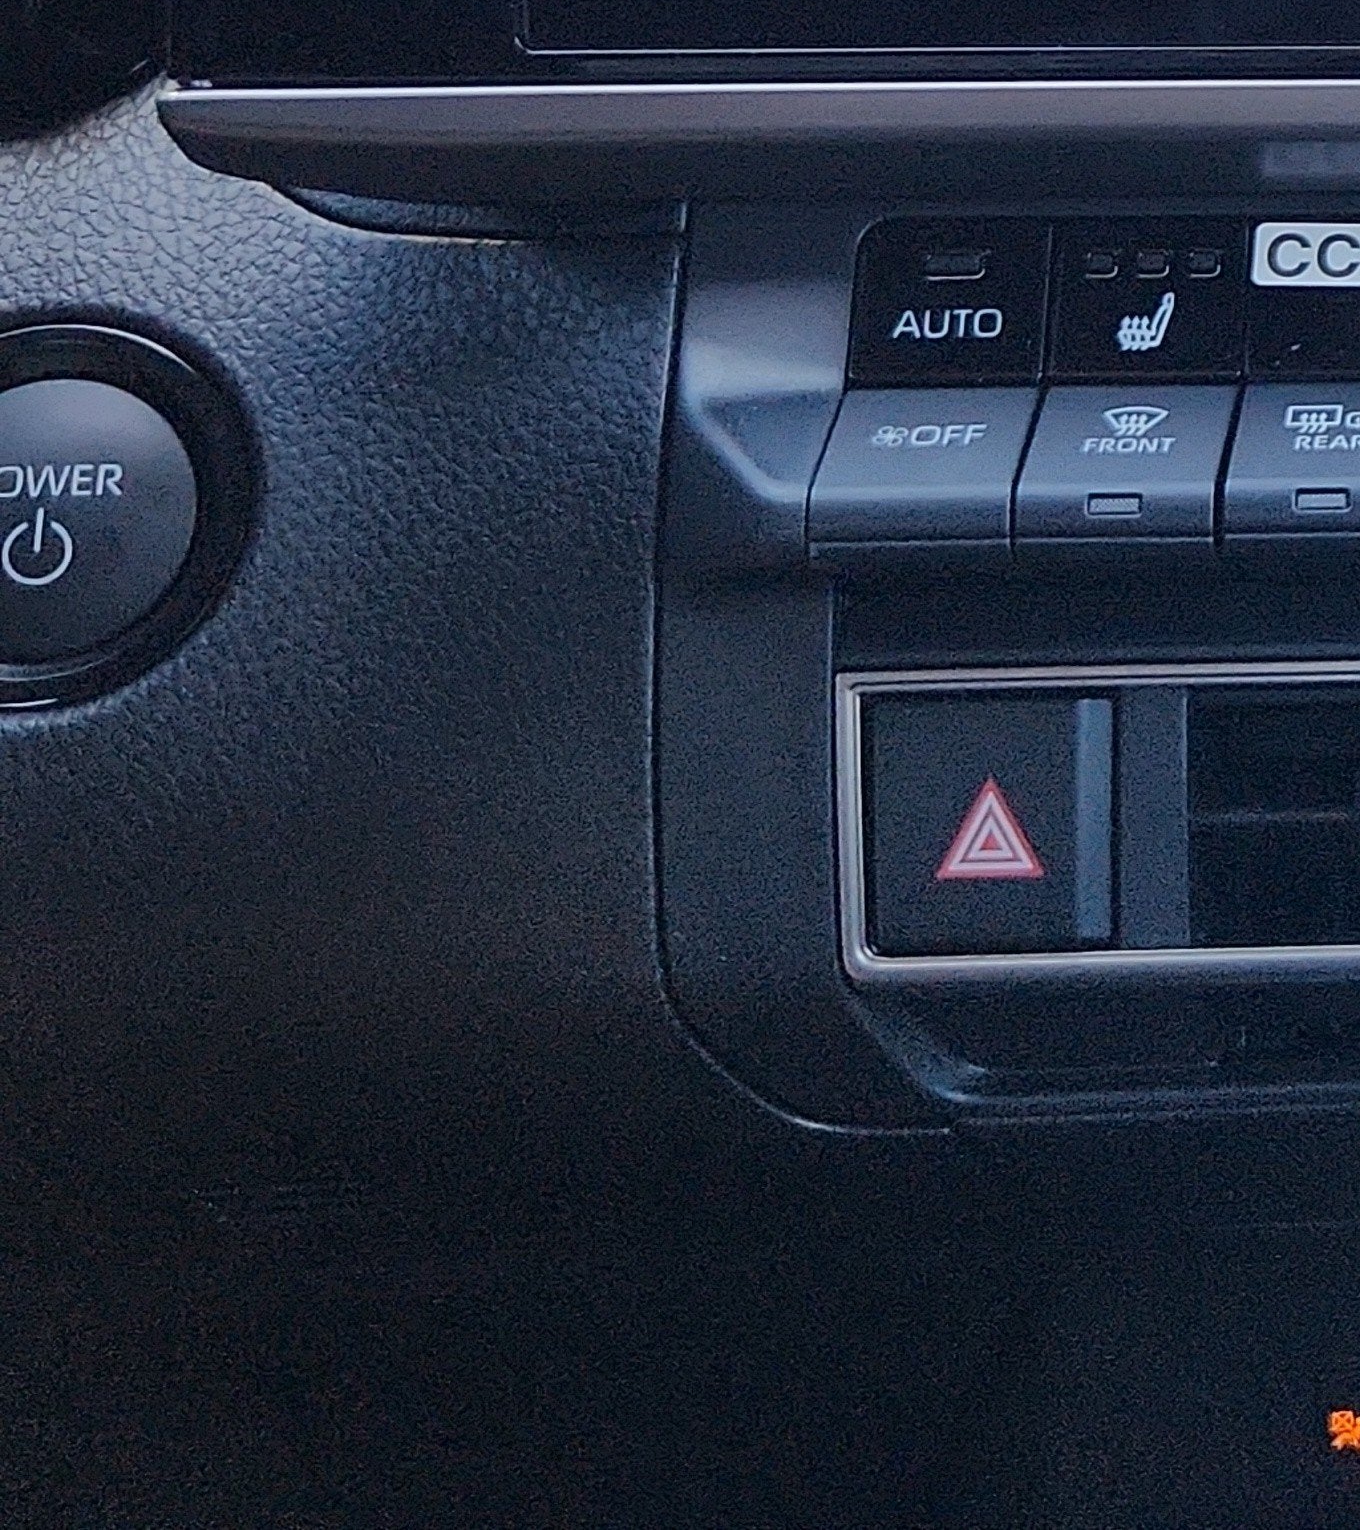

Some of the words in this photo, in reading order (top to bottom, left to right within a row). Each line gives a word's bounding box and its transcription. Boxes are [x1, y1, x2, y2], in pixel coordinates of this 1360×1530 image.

[1267, 232, 1360, 278] CC
[892, 307, 1003, 340] AUTO
[908, 423, 988, 449] OFF
[1081, 435, 1177, 454] FRONT
